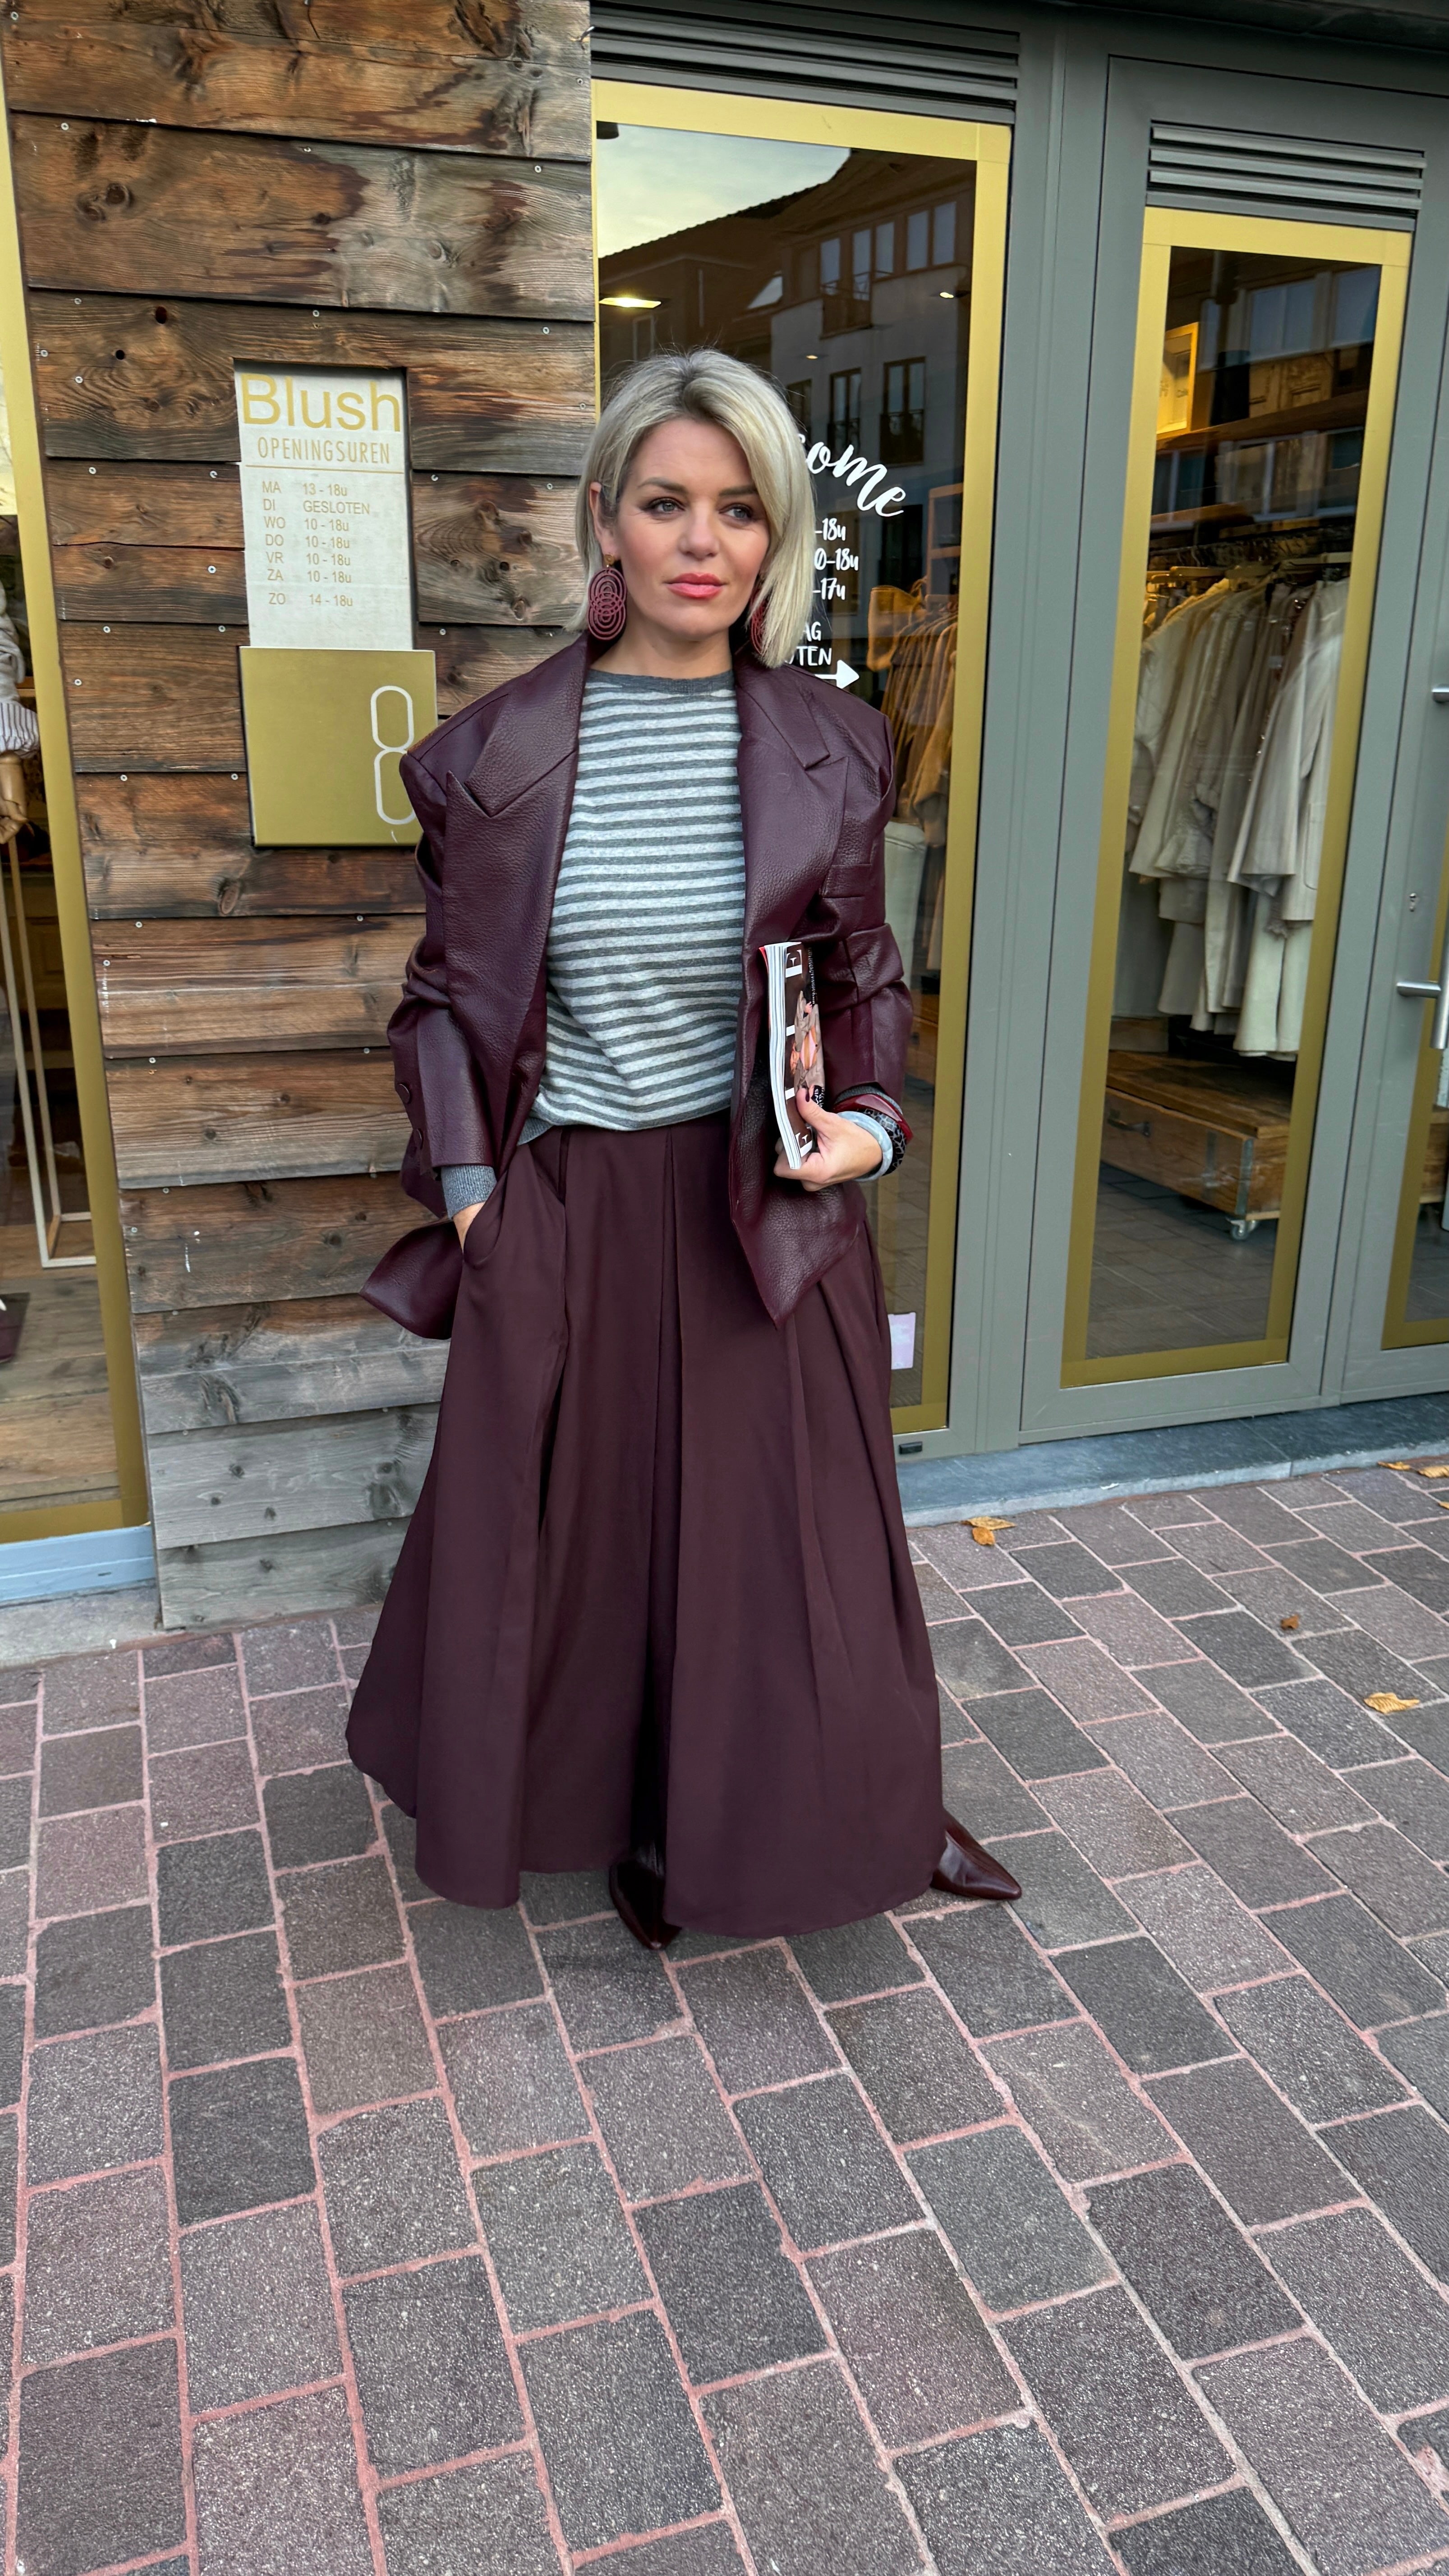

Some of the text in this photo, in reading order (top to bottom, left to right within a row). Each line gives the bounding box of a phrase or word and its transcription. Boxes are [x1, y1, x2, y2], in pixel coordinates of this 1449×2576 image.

[240, 373, 400, 432] Blush
[258, 437, 390, 464] OPENINGSUREN
[798, 433, 906, 517] ome
[262, 481, 281, 493] MA
[303, 483, 316, 495] 13
[327, 484, 347, 496] 18u
[263, 498, 370, 515] DI GESLOTEN
[263, 516, 285, 529] WO
[304, 518, 317, 530] 10
[329, 519, 349, 531] 18u
[265, 534, 284, 546] DO
[305, 535, 318, 547] 10
[331, 537, 350, 548] 18u
[266, 552, 284, 564] VR
[306, 553, 319, 565] 10
[331, 554, 350, 566] 18u
[267, 569, 284, 581] ZA
[307, 570, 320, 582] 10
[332, 571, 351, 583] 18u
[268, 593, 286, 605] ZO
[309, 593, 321, 605] 14
[333, 595, 353, 607] 18u
[370, 685, 416, 825] 8
